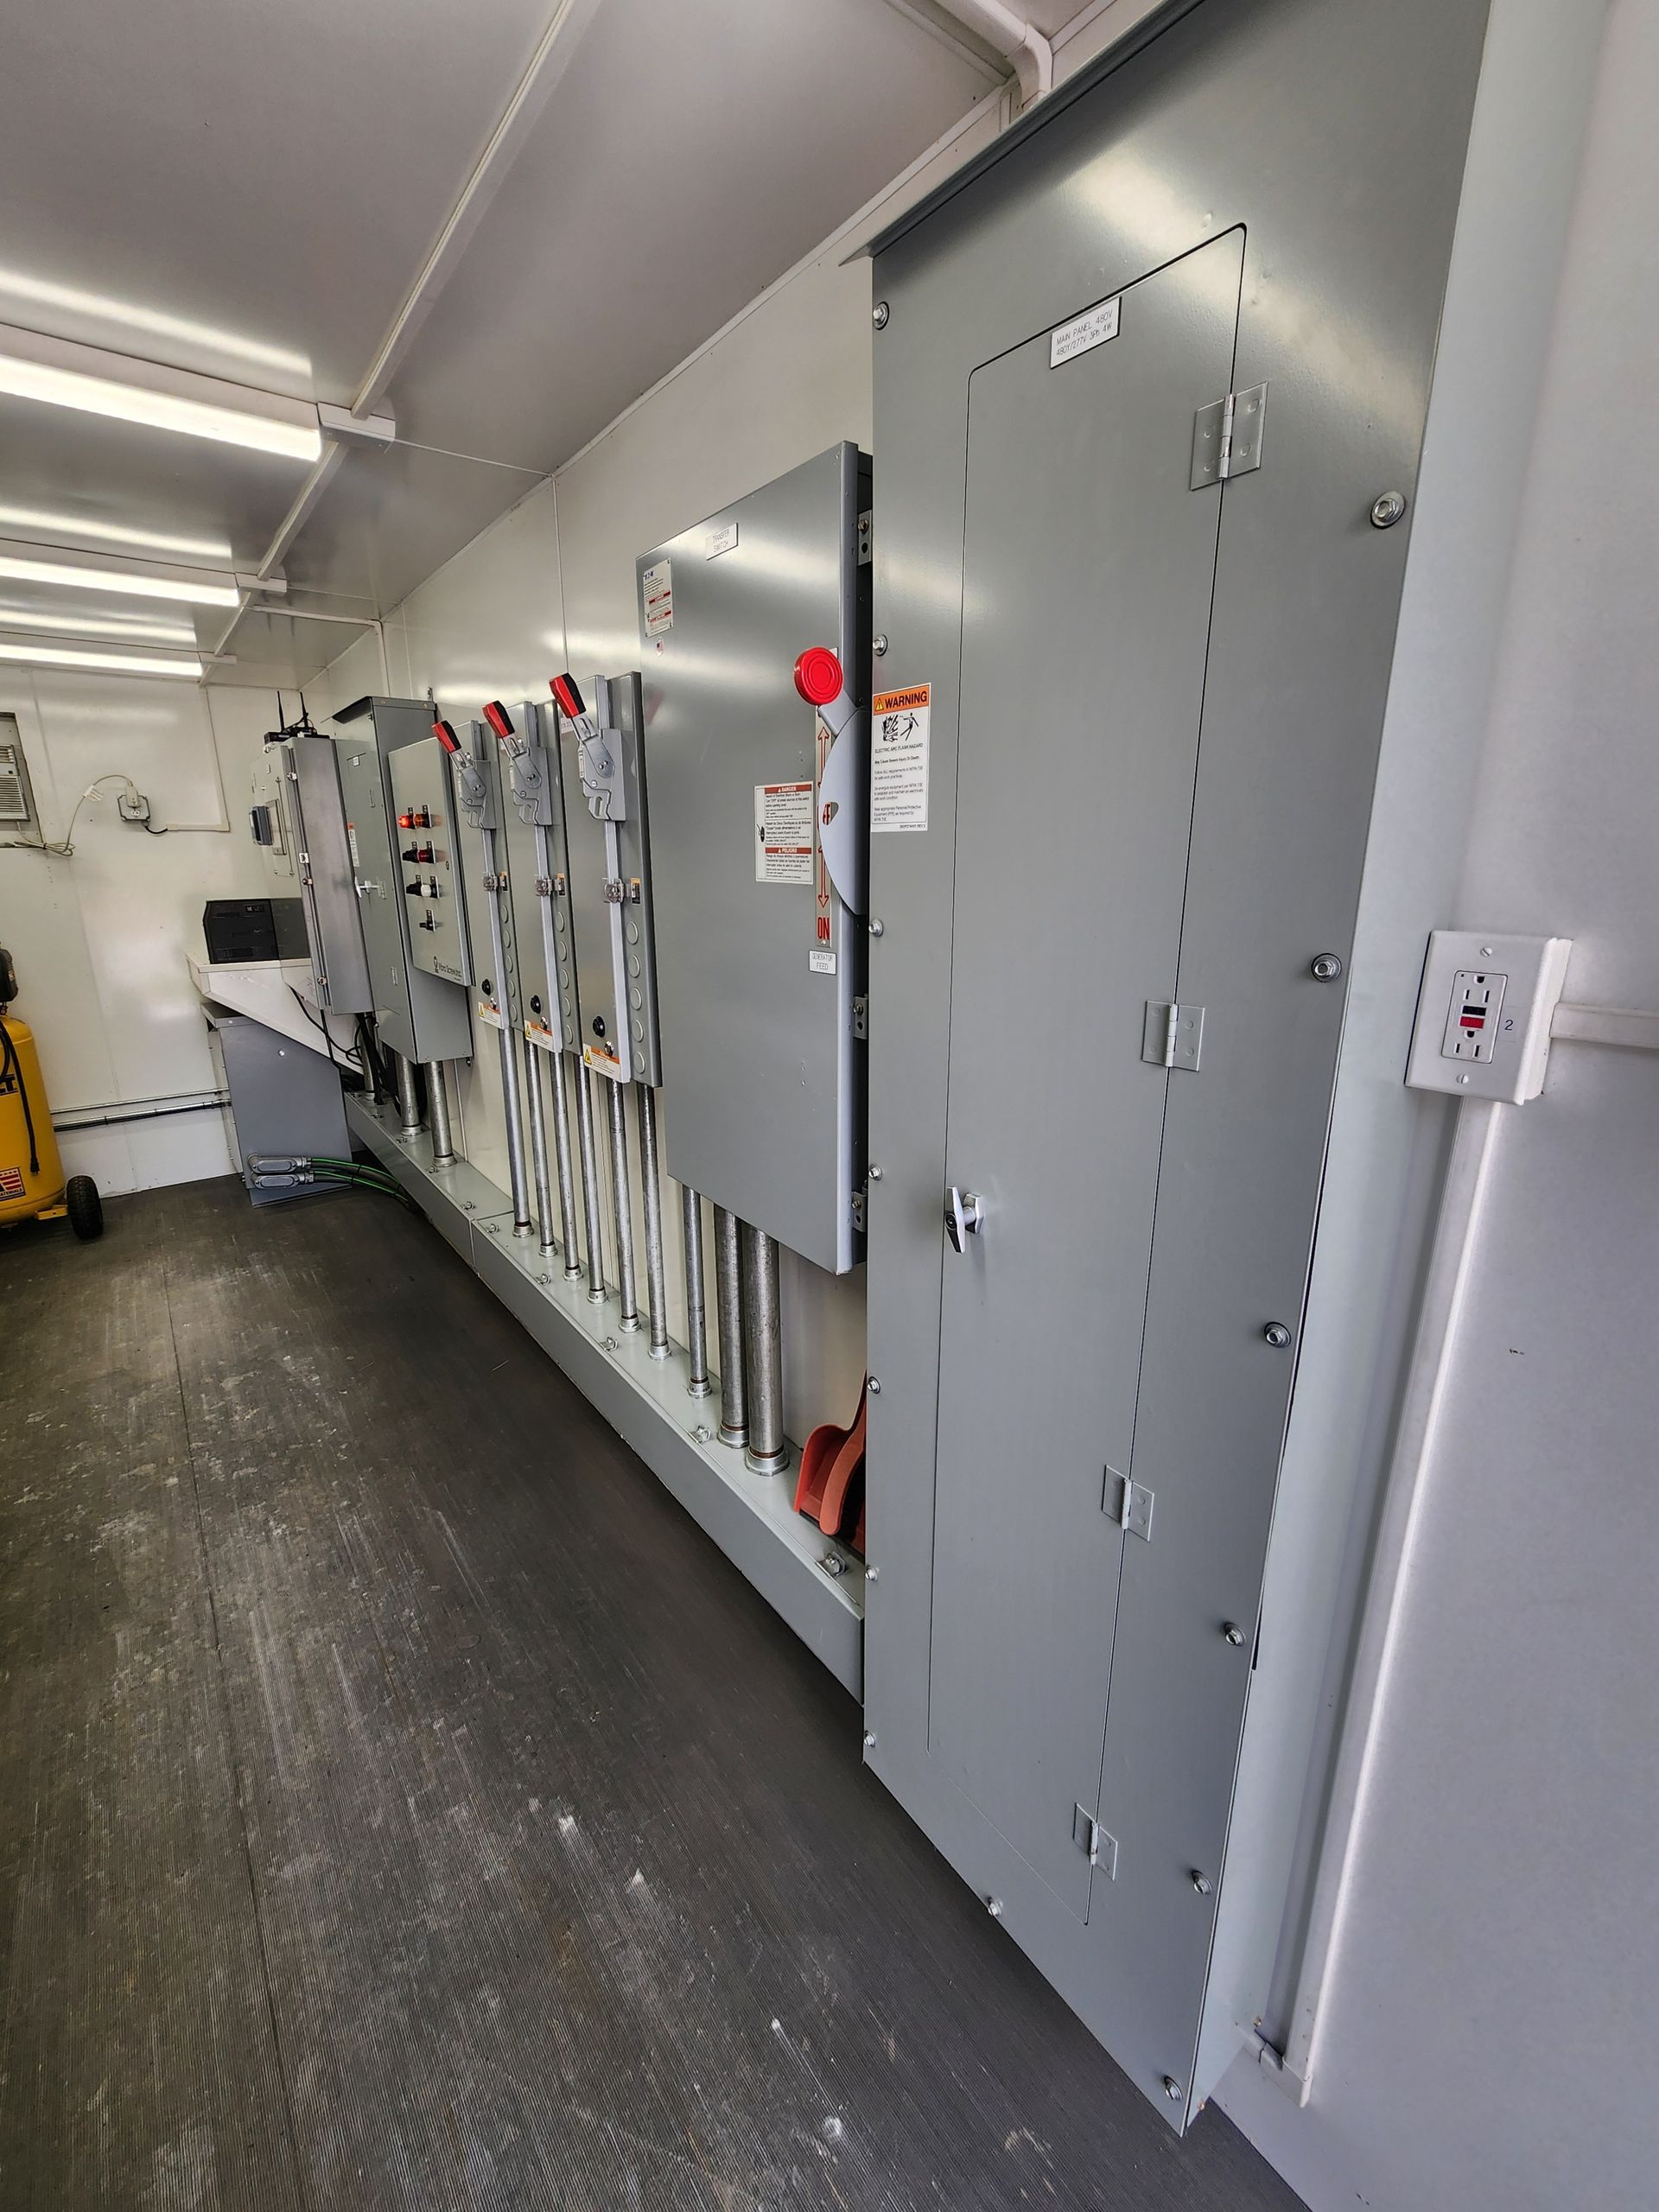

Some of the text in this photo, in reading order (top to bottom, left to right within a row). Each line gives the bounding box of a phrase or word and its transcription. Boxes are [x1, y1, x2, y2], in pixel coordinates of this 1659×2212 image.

[1057, 309, 1113, 345] MAIN PANEL 480V
[885, 690, 927, 709] WARNING
[817, 917, 830, 940] ON
[816, 962, 829, 970] FEED
[1504, 1019, 1514, 1031] 2
